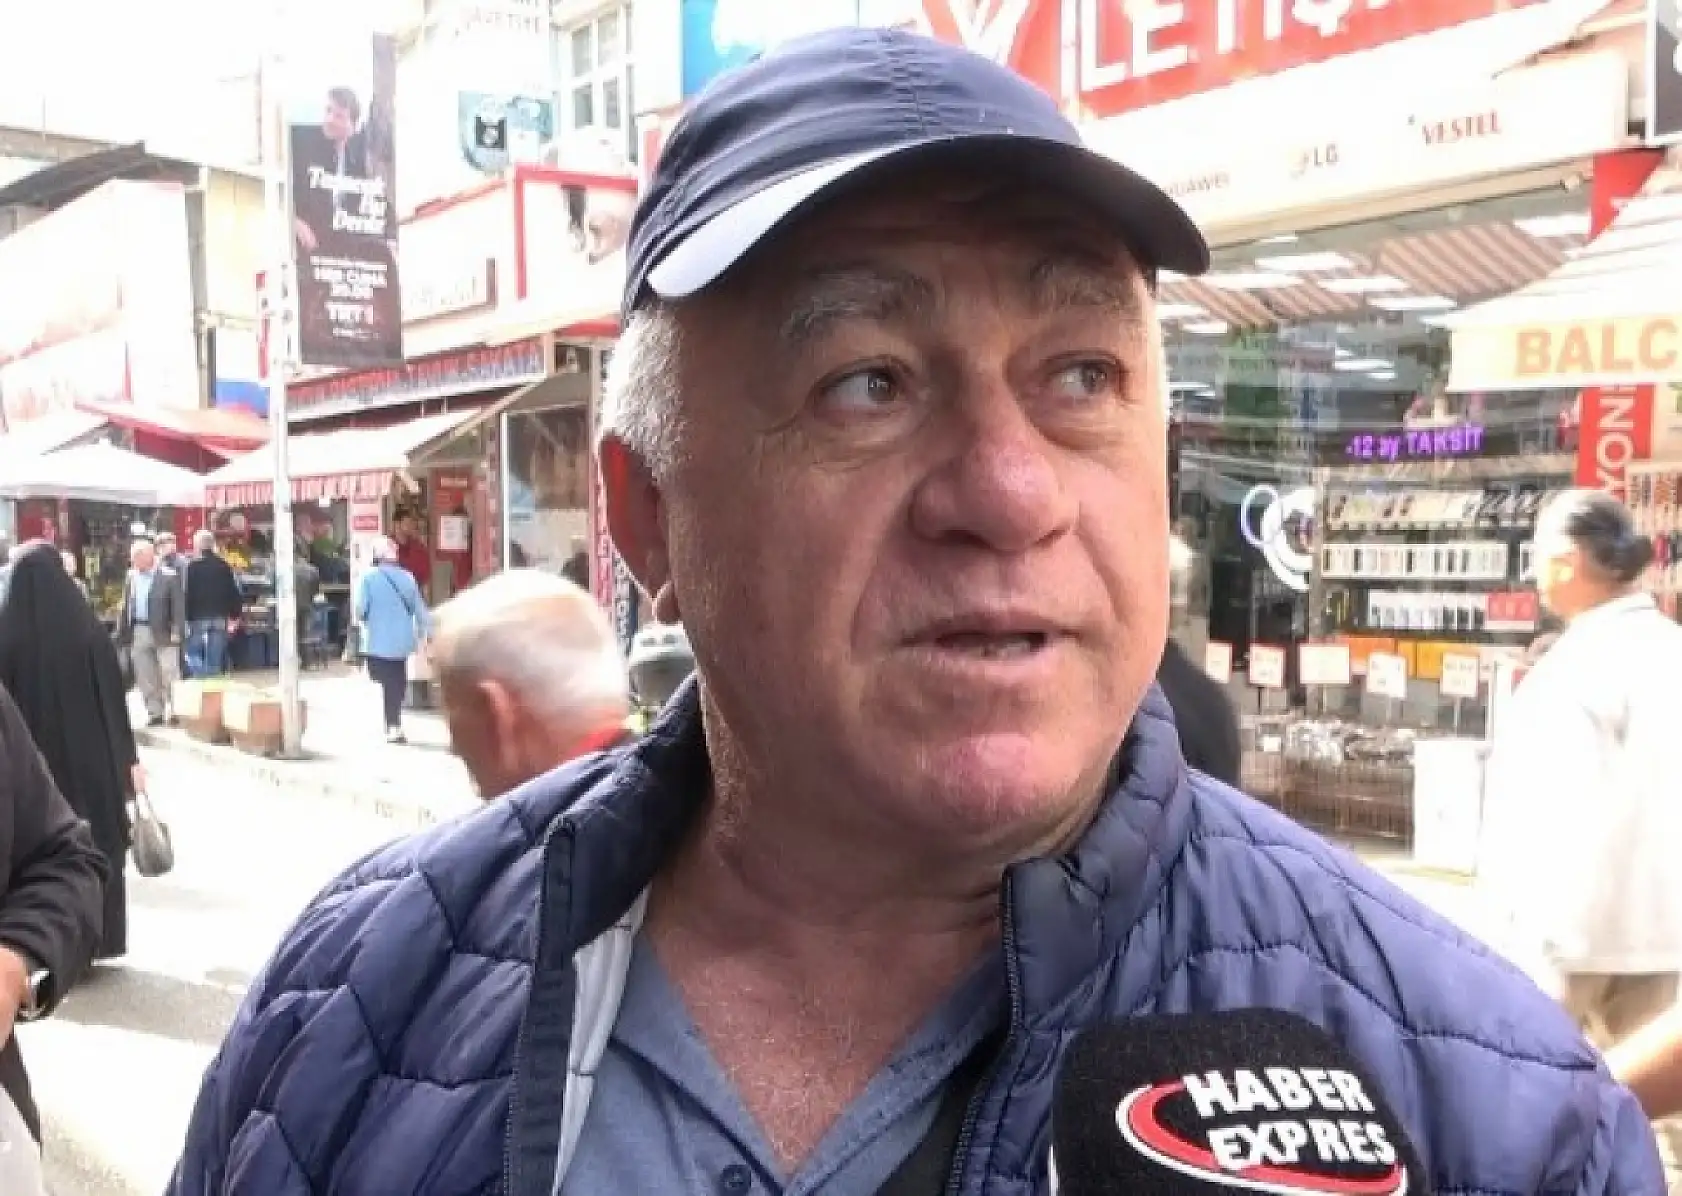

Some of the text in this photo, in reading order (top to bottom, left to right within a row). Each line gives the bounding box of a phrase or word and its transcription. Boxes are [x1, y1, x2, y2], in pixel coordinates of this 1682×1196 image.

[1421, 109, 1501, 146] VESTEL
[1313, 144, 1338, 167] LG
[1183, 1066, 1375, 1117] HABER
[1206, 1118, 1396, 1170] EXPRES
